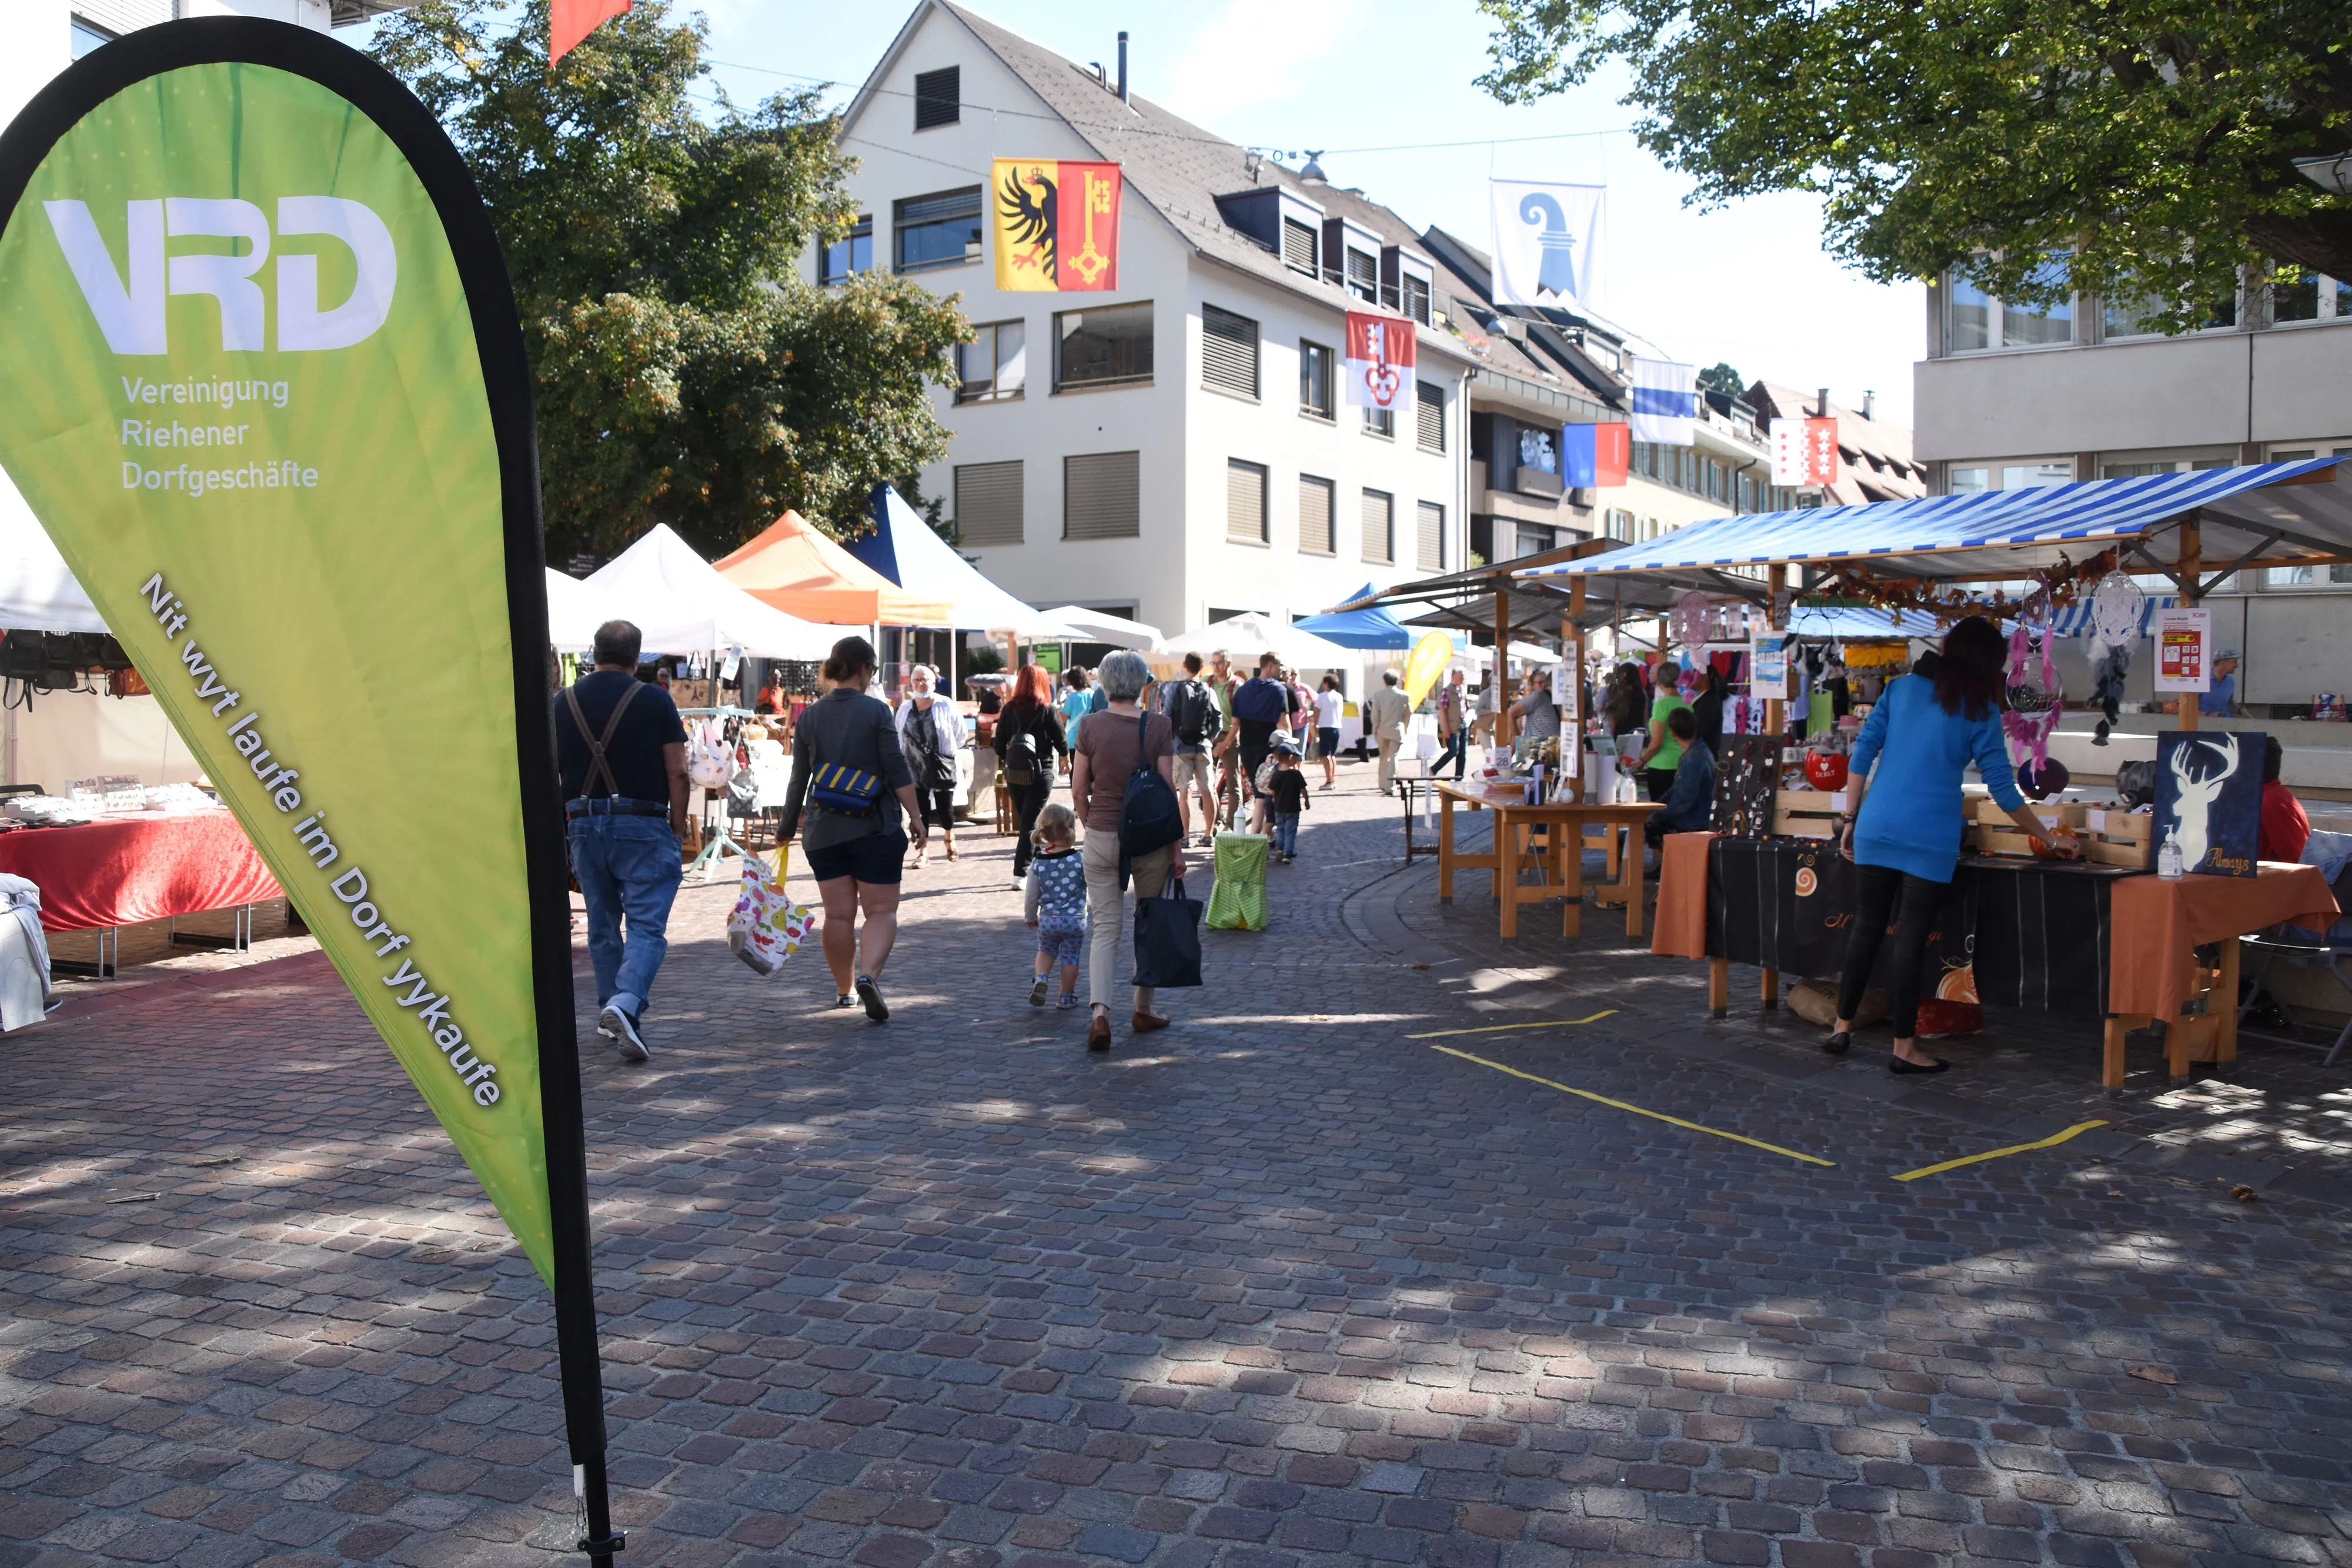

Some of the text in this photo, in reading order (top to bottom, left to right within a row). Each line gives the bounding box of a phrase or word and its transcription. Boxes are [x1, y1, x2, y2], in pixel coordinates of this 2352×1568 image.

[42, 195, 397, 355] VRD
[121, 374, 289, 409] Vereinigung
[121, 419, 250, 448] Riehener
[121, 460, 319, 498] Dorfgeschäfte
[1496, 757, 1509, 767] 28
[139, 571, 500, 1107] Nit wyt laufe im Dorf yykaufe
[2206, 847, 2249, 875] Always
